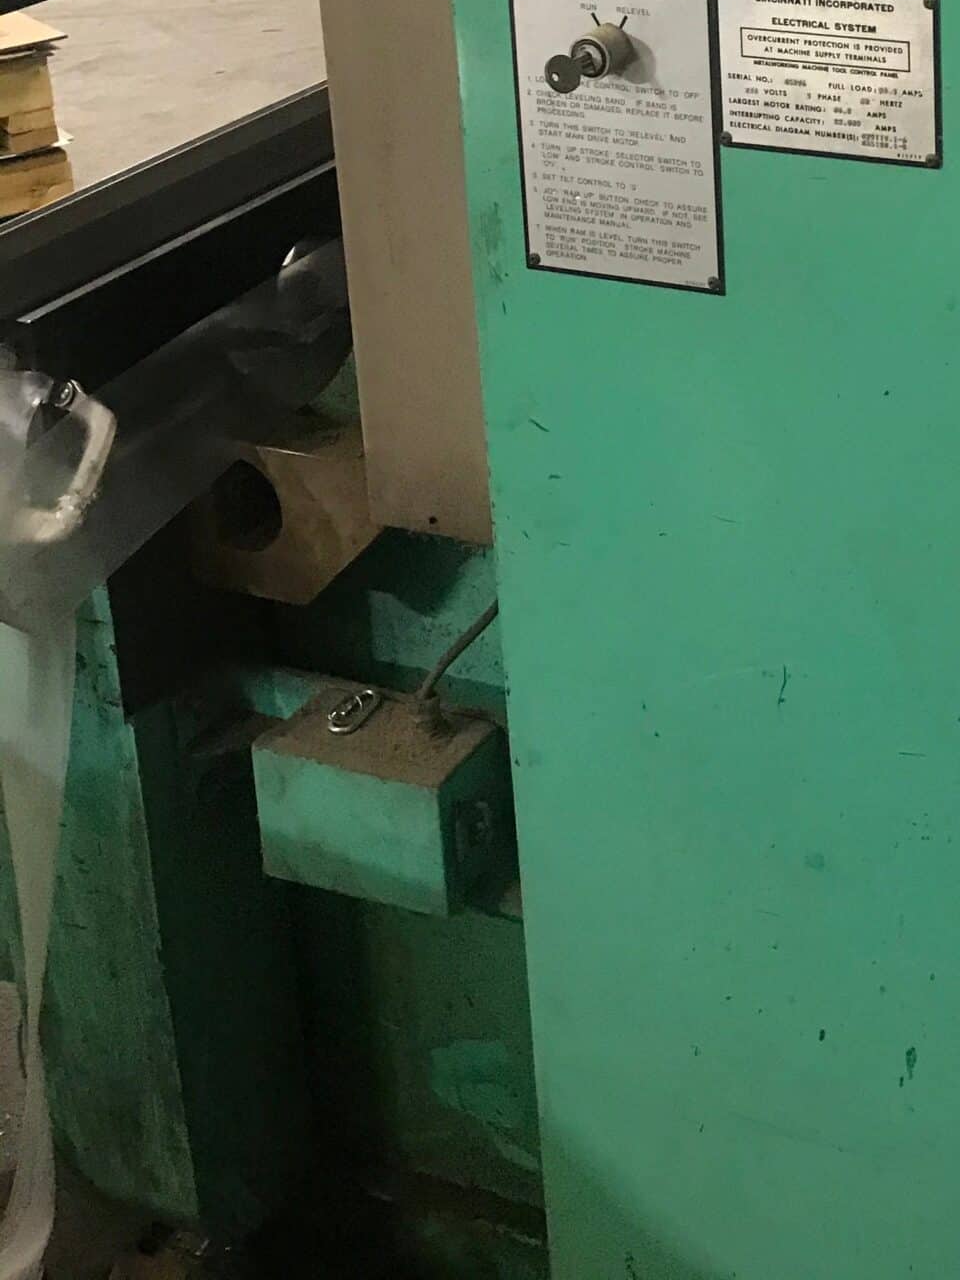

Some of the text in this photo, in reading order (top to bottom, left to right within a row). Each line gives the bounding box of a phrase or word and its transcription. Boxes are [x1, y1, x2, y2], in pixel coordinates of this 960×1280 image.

[579, 2, 597, 12] RUN
[615, 6, 650, 17] RELEVEL
[815, 0, 894, 13] INCORPORATED
[771, 17, 876, 34] ELECTRICAL SYSTEM
[746, 34, 903, 54] OVERCURRENT PROTECTION IS PROVIDED
[763, 45, 886, 63] AT MACHINE SUPPLY TERMINALS
[727, 72, 772, 84] SERIAL NO.:
